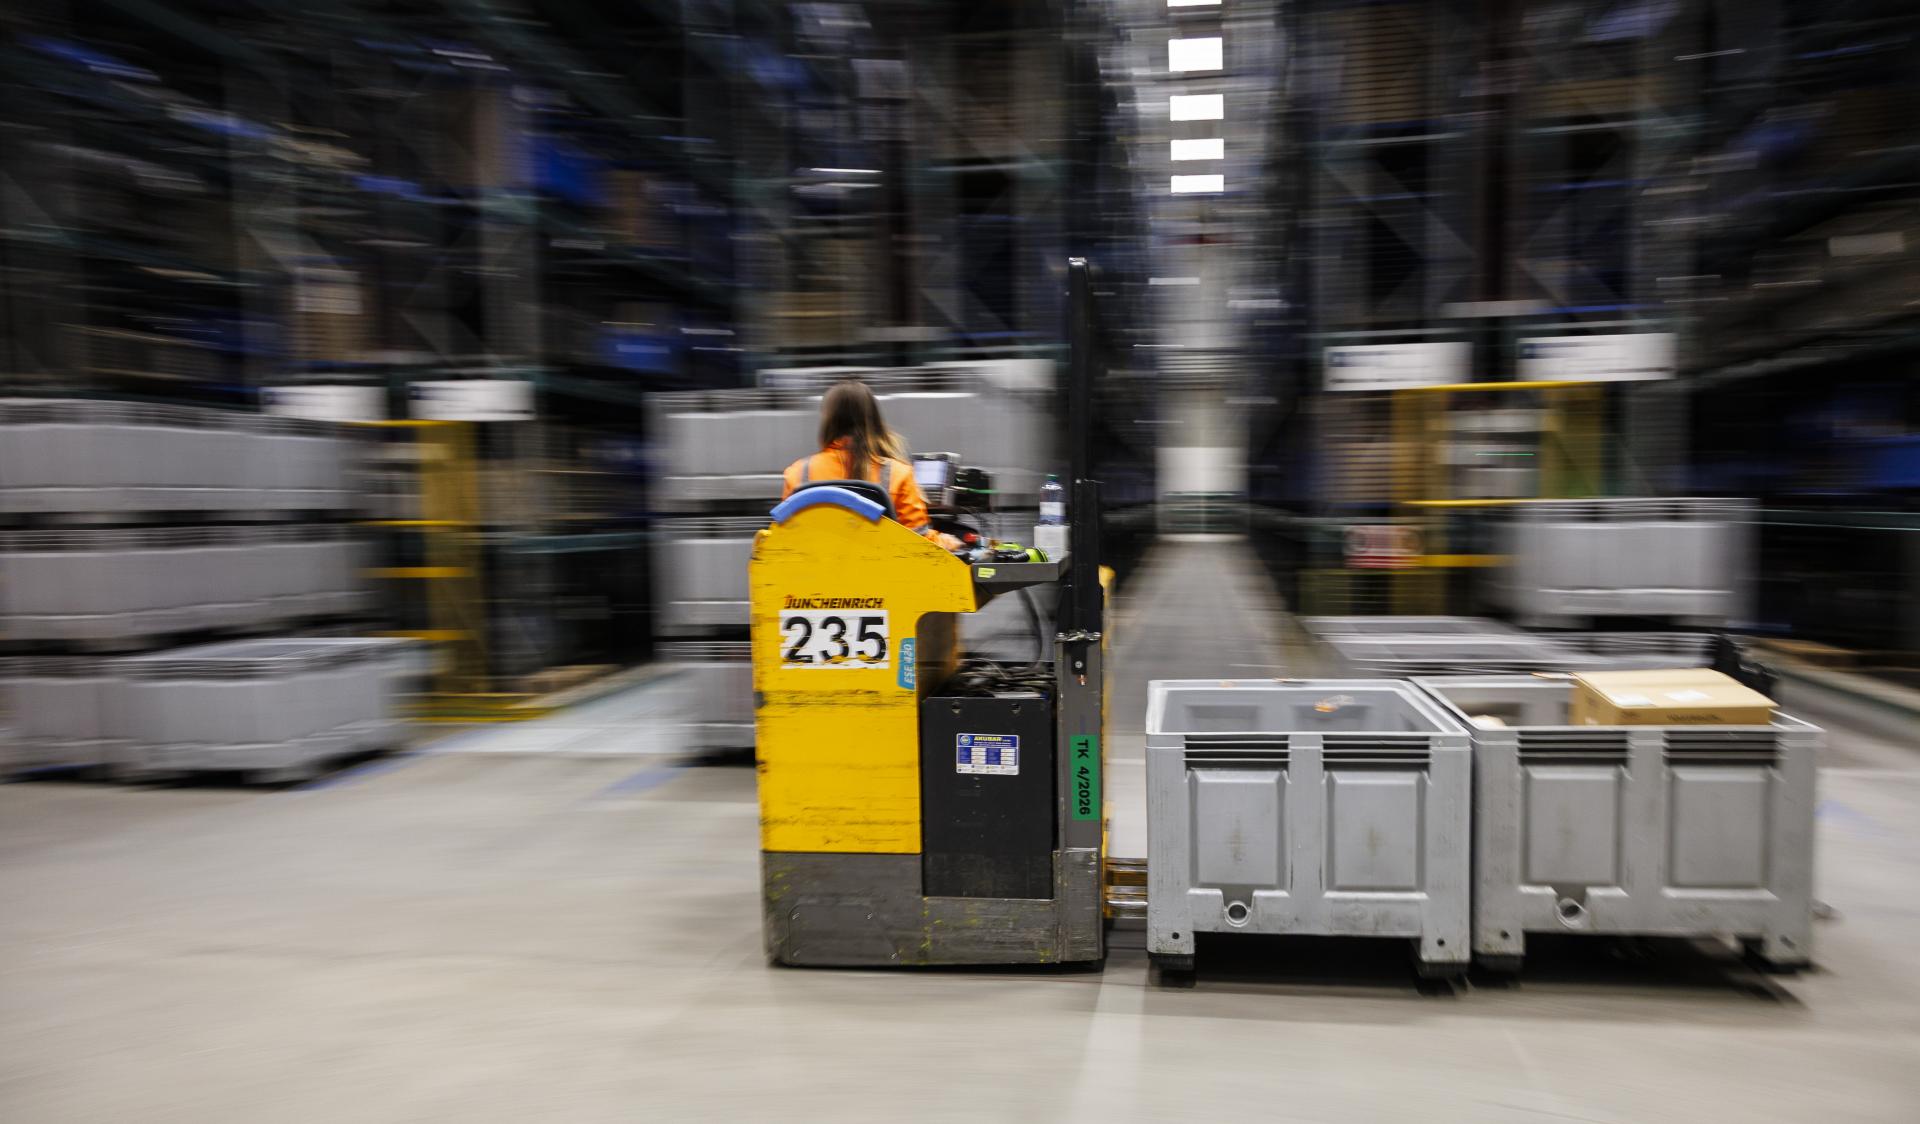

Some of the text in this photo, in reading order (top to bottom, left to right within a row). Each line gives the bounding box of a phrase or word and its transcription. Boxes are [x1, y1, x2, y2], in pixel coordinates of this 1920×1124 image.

[783, 616, 886, 664] 235
[1077, 739, 1090, 815] TK 4/2026
